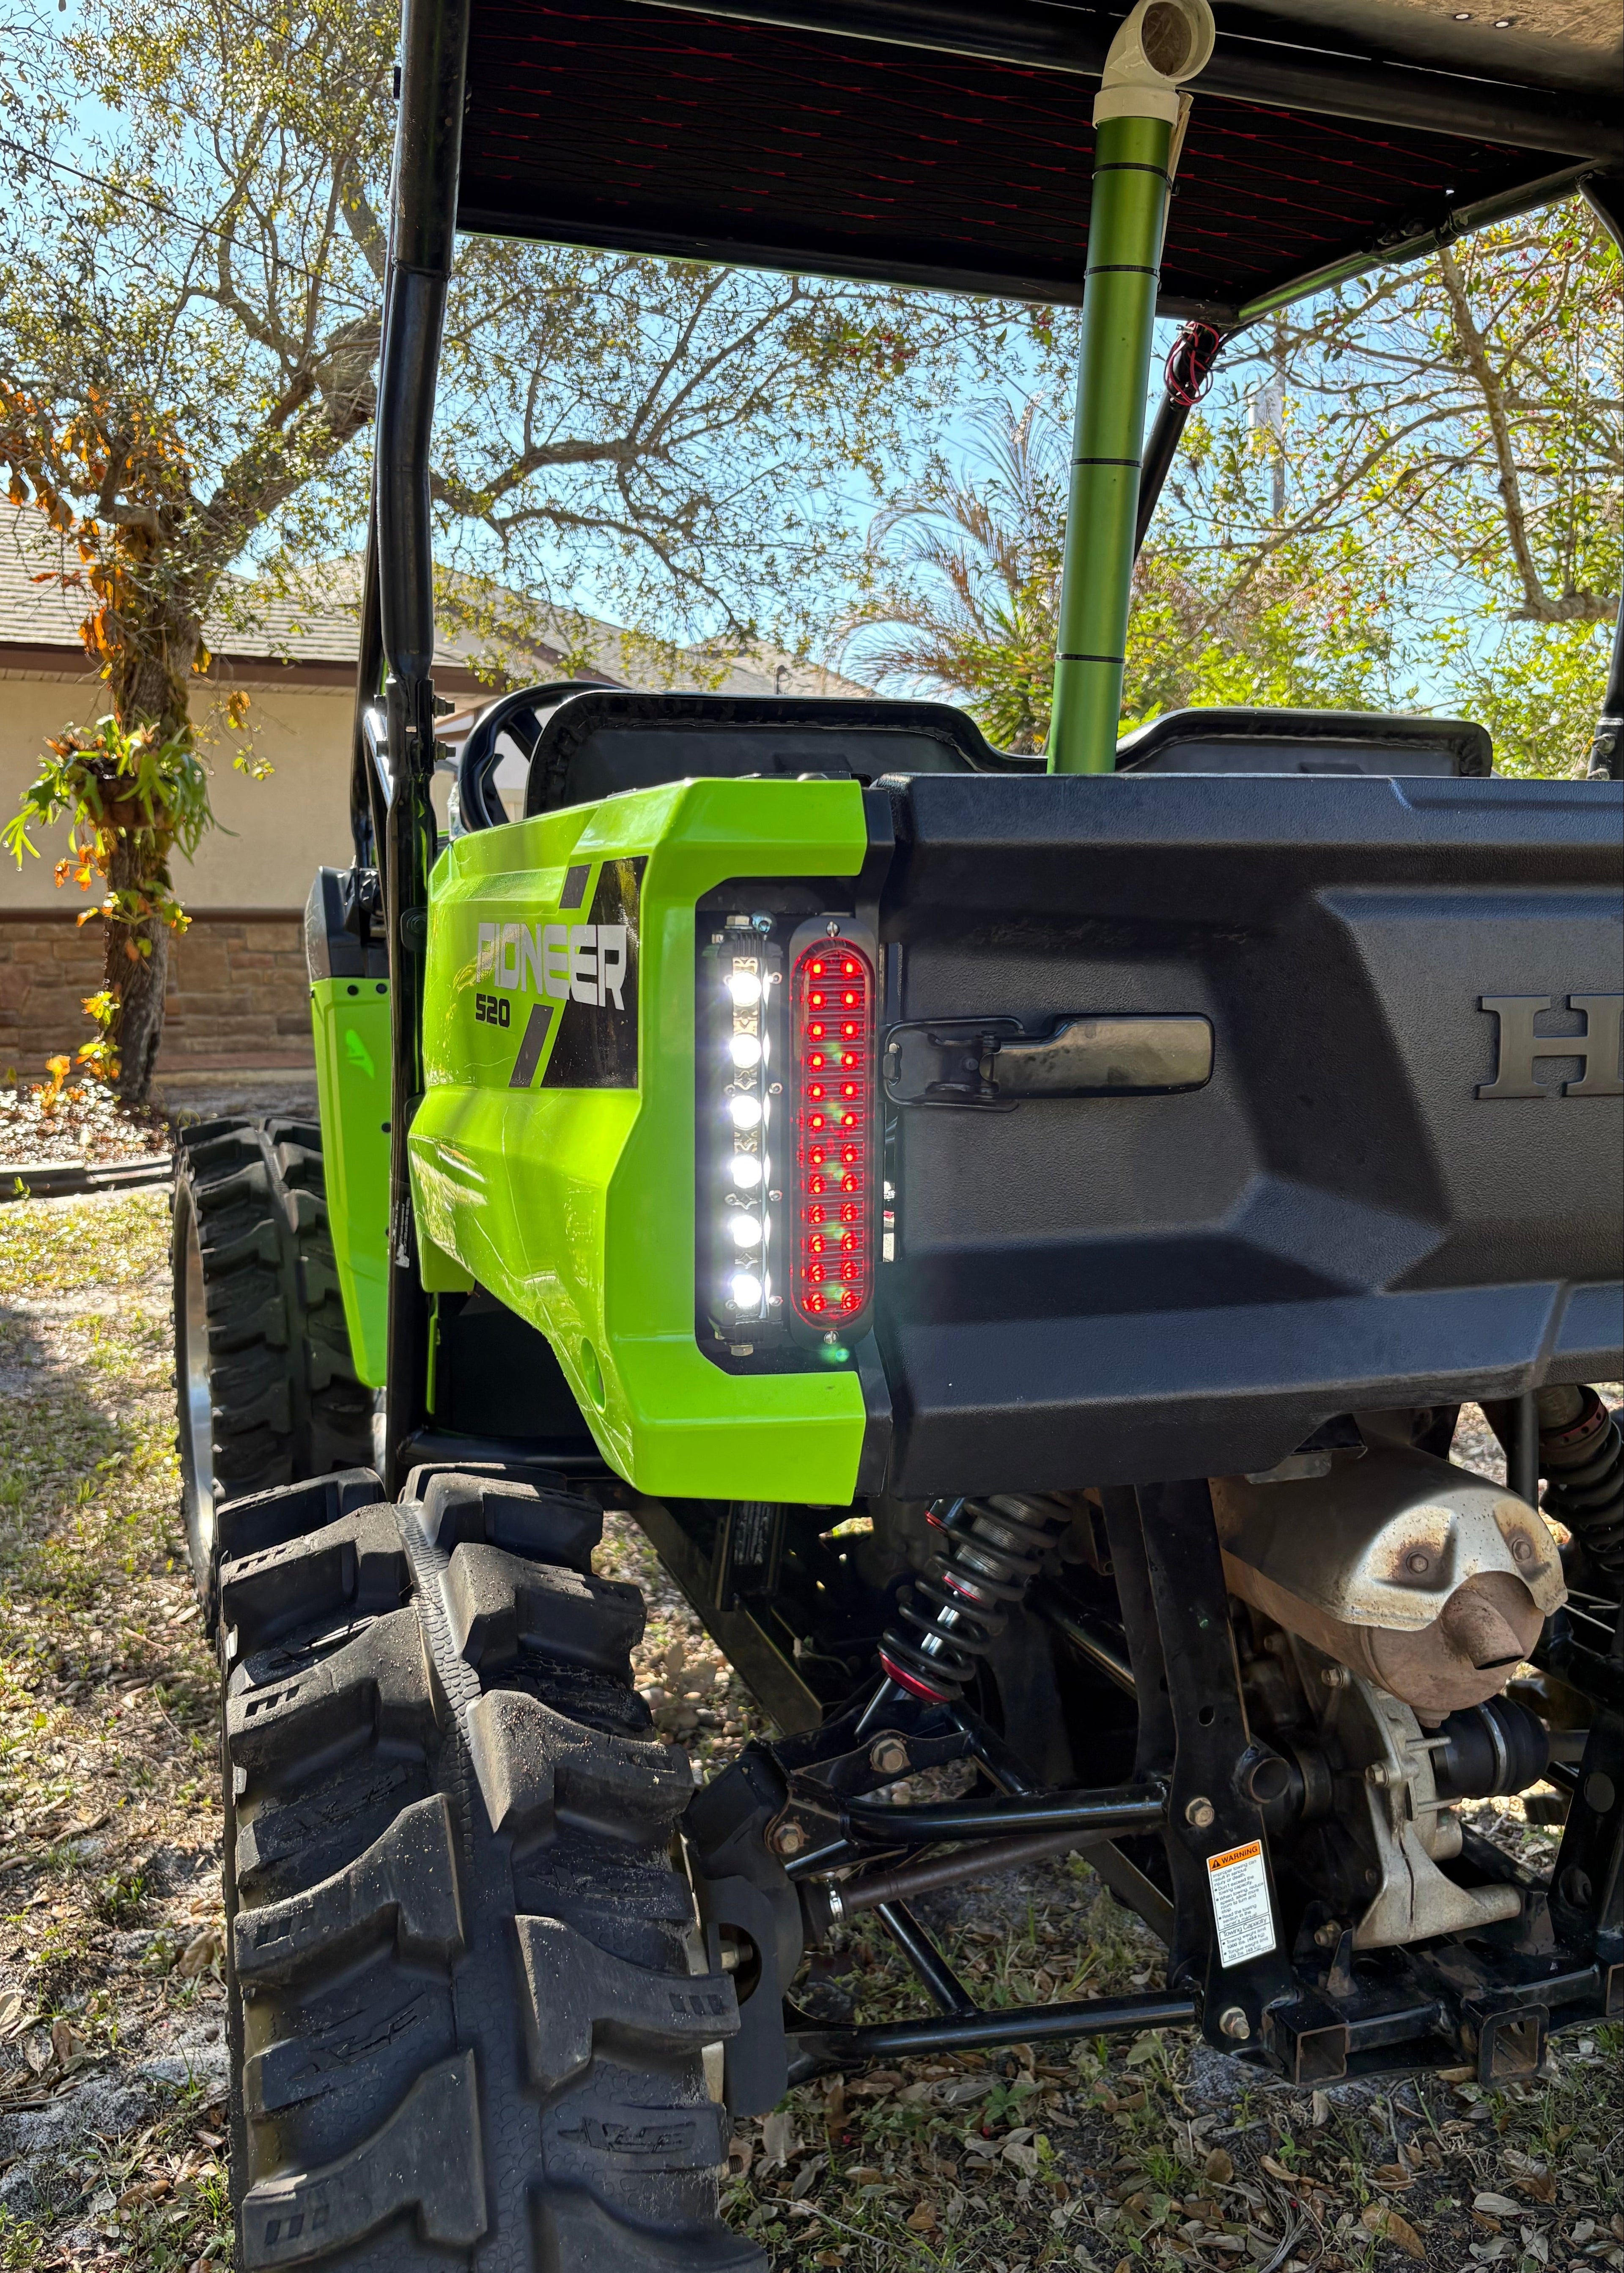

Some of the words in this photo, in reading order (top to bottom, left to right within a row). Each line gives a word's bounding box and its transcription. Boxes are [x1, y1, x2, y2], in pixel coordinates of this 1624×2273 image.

[476, 922, 626, 1010] PIONEER
[475, 993, 510, 1028] 520
[1221, 1846, 1258, 1864] WARNING
